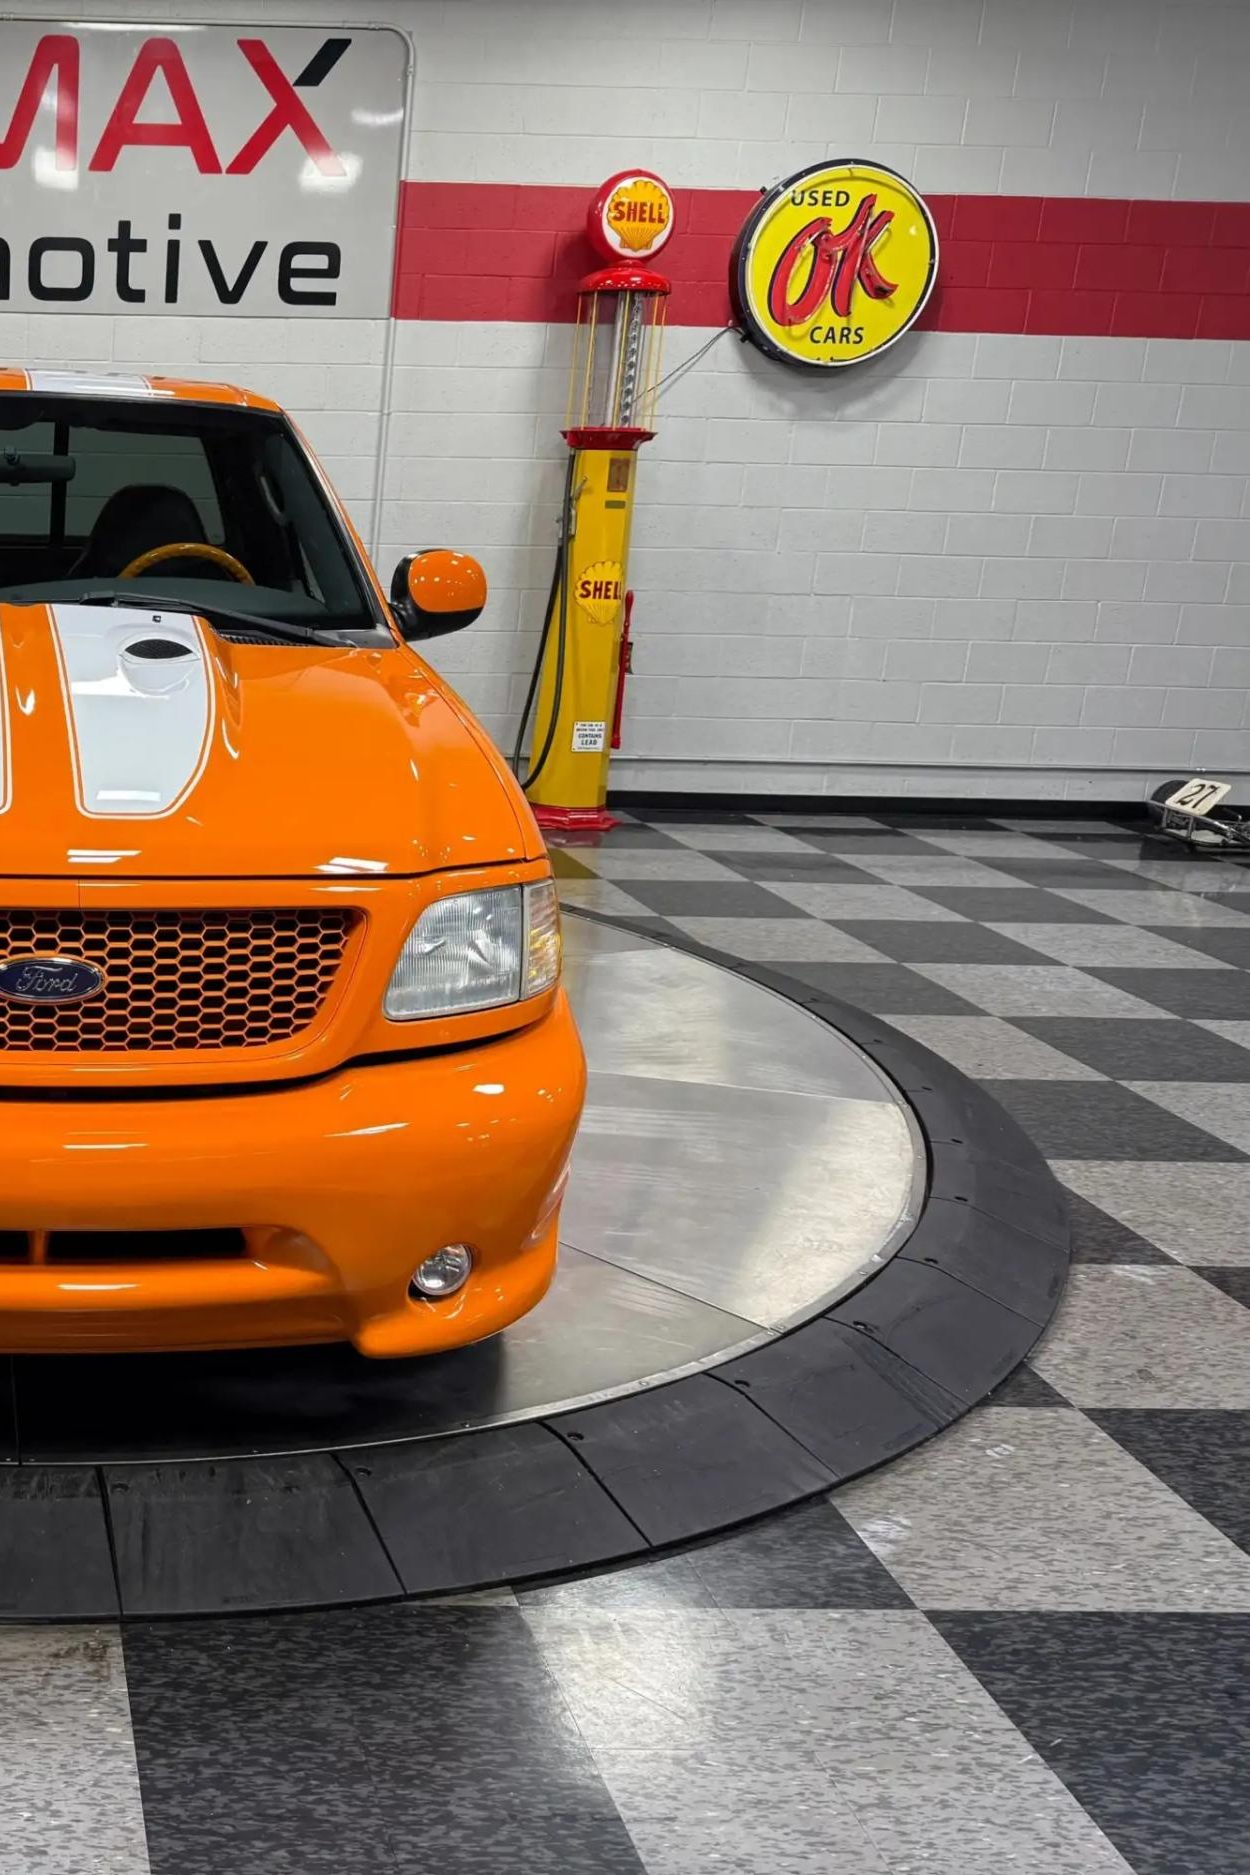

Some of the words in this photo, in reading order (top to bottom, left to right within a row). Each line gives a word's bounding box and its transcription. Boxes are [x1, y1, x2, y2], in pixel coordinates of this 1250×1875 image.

[790, 189, 851, 207] USED
[611, 200, 666, 225] SHELL
[767, 192, 900, 327] OK
[809, 325, 865, 345] CARS
[1175, 783, 1220, 809] 27
[15, 964, 80, 992] Ford
